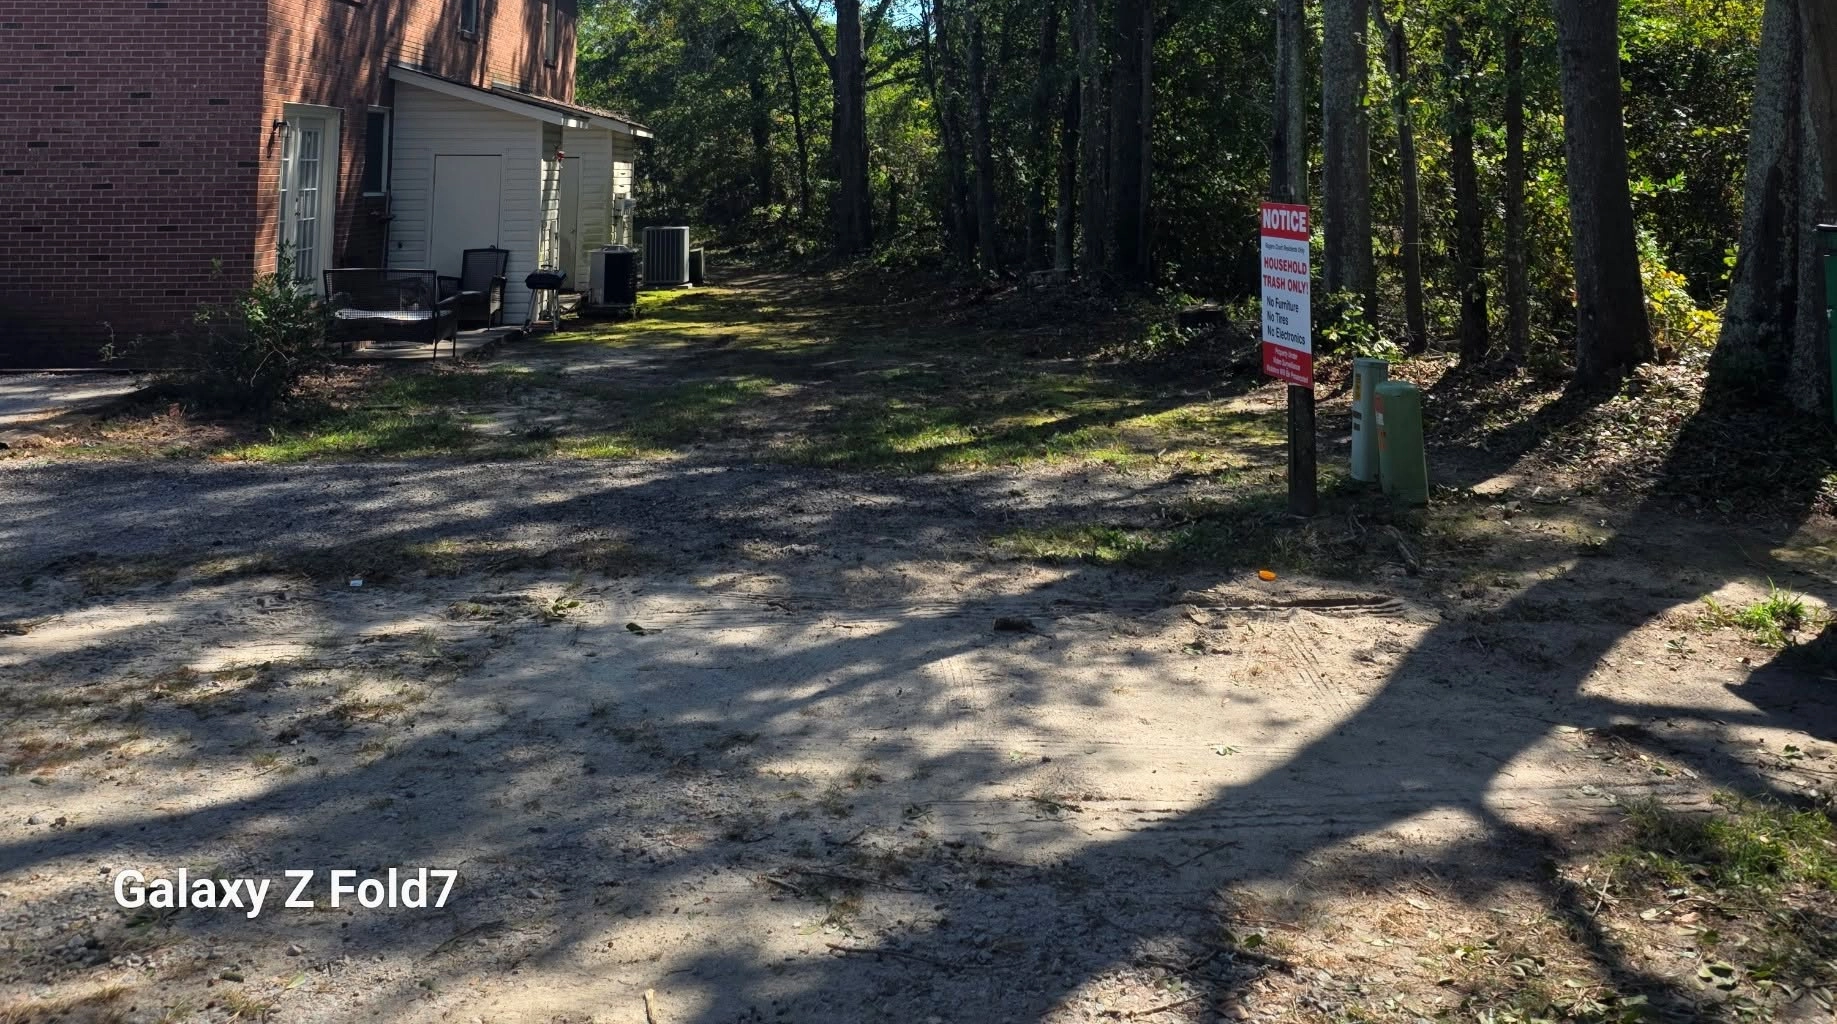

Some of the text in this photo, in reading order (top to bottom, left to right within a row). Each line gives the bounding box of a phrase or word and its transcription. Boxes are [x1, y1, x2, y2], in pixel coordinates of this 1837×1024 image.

[1263, 208, 1306, 232] NOTICE
[1264, 257, 1307, 275] HOUSEHOLD
[1263, 274, 1308, 295] TRASH ONLY!
[1267, 296, 1299, 312] No Furniture
[1267, 311, 1288, 325] No Tires
[1267, 324, 1305, 345] No Electronics
